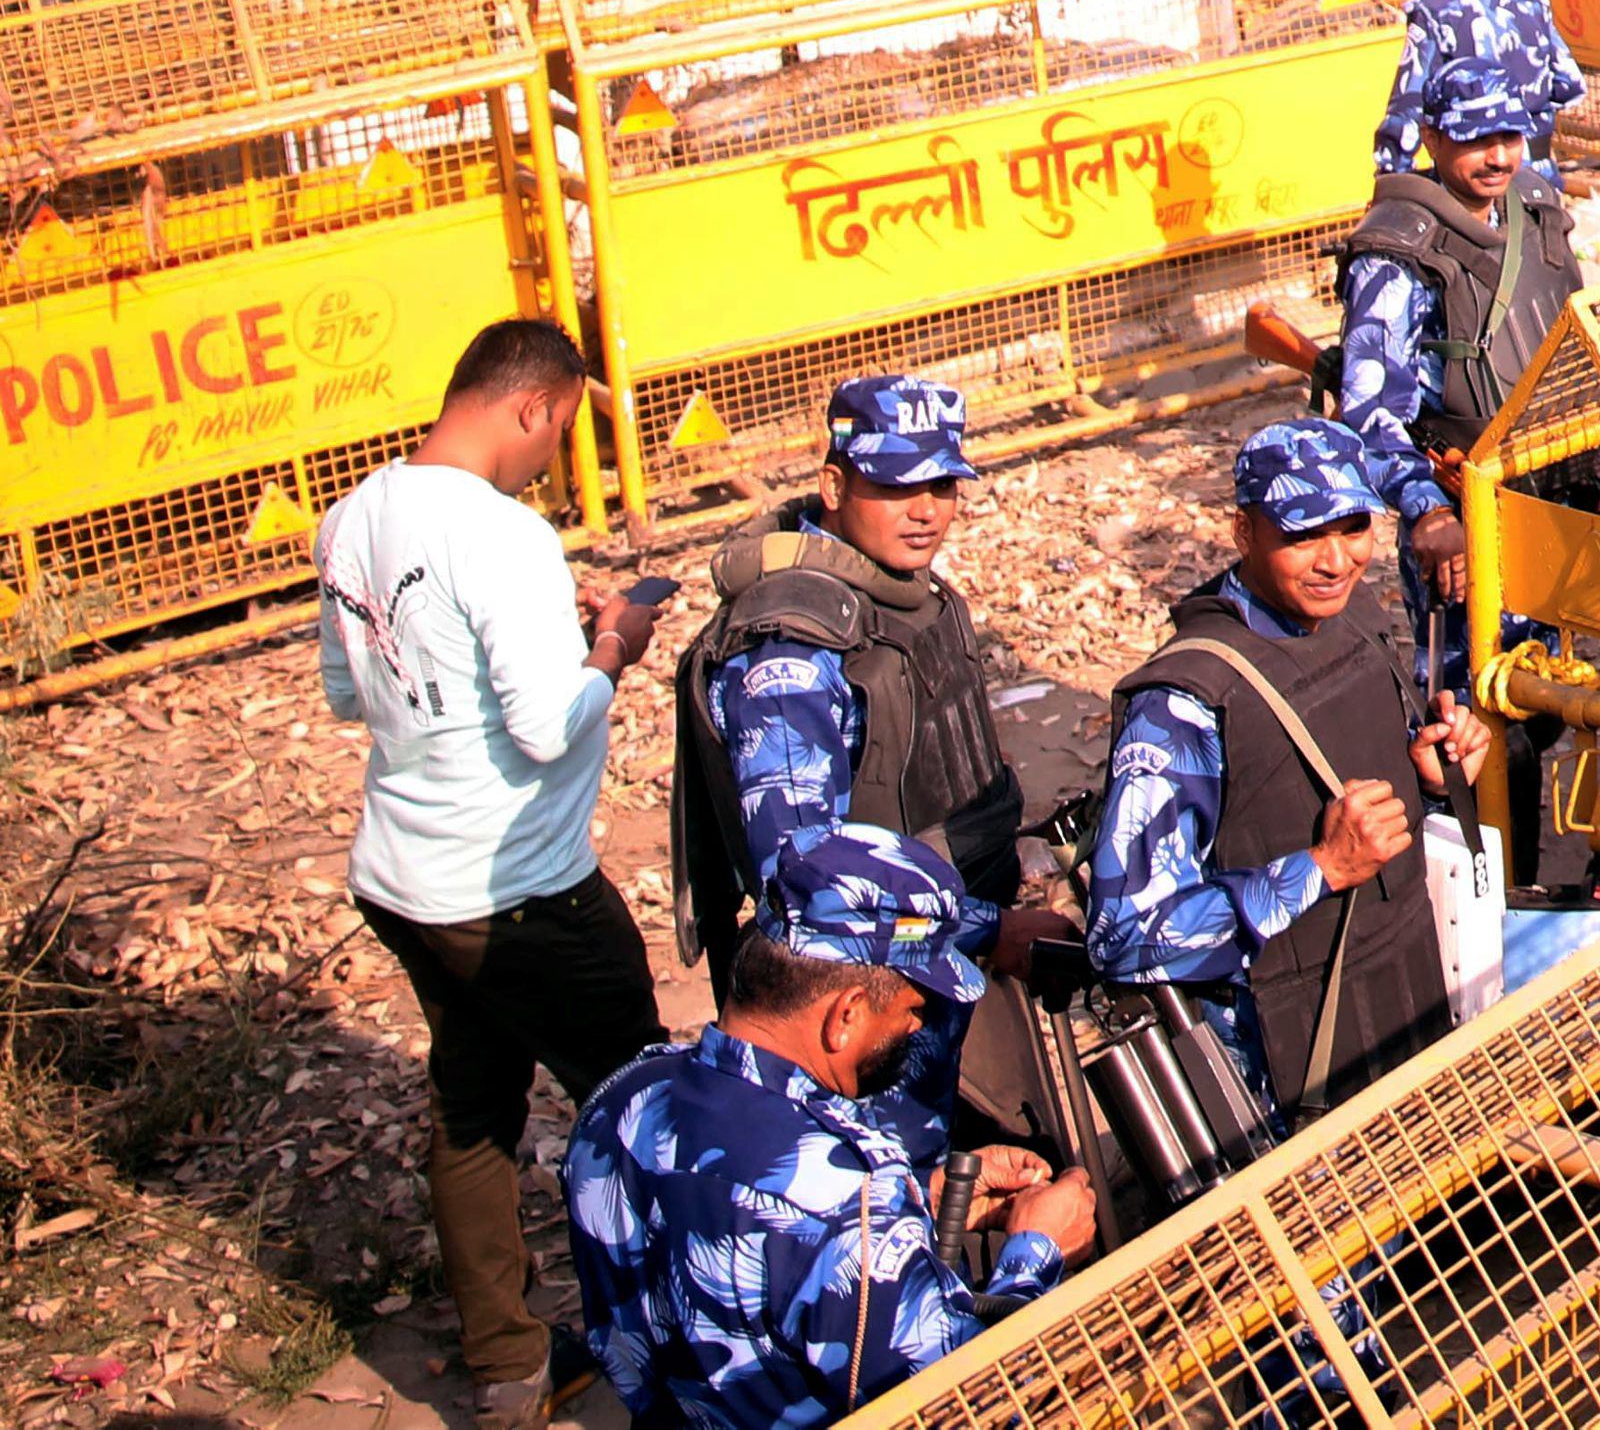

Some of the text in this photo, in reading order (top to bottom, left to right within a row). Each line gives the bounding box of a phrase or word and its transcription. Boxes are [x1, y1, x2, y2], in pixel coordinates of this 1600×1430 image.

[781, 111, 1172, 273] दिल्ली पुलिस
[0, 301, 298, 445] POLICE
[192, 397, 296, 446] MAYUR
[313, 362, 394, 413] VIHAR
